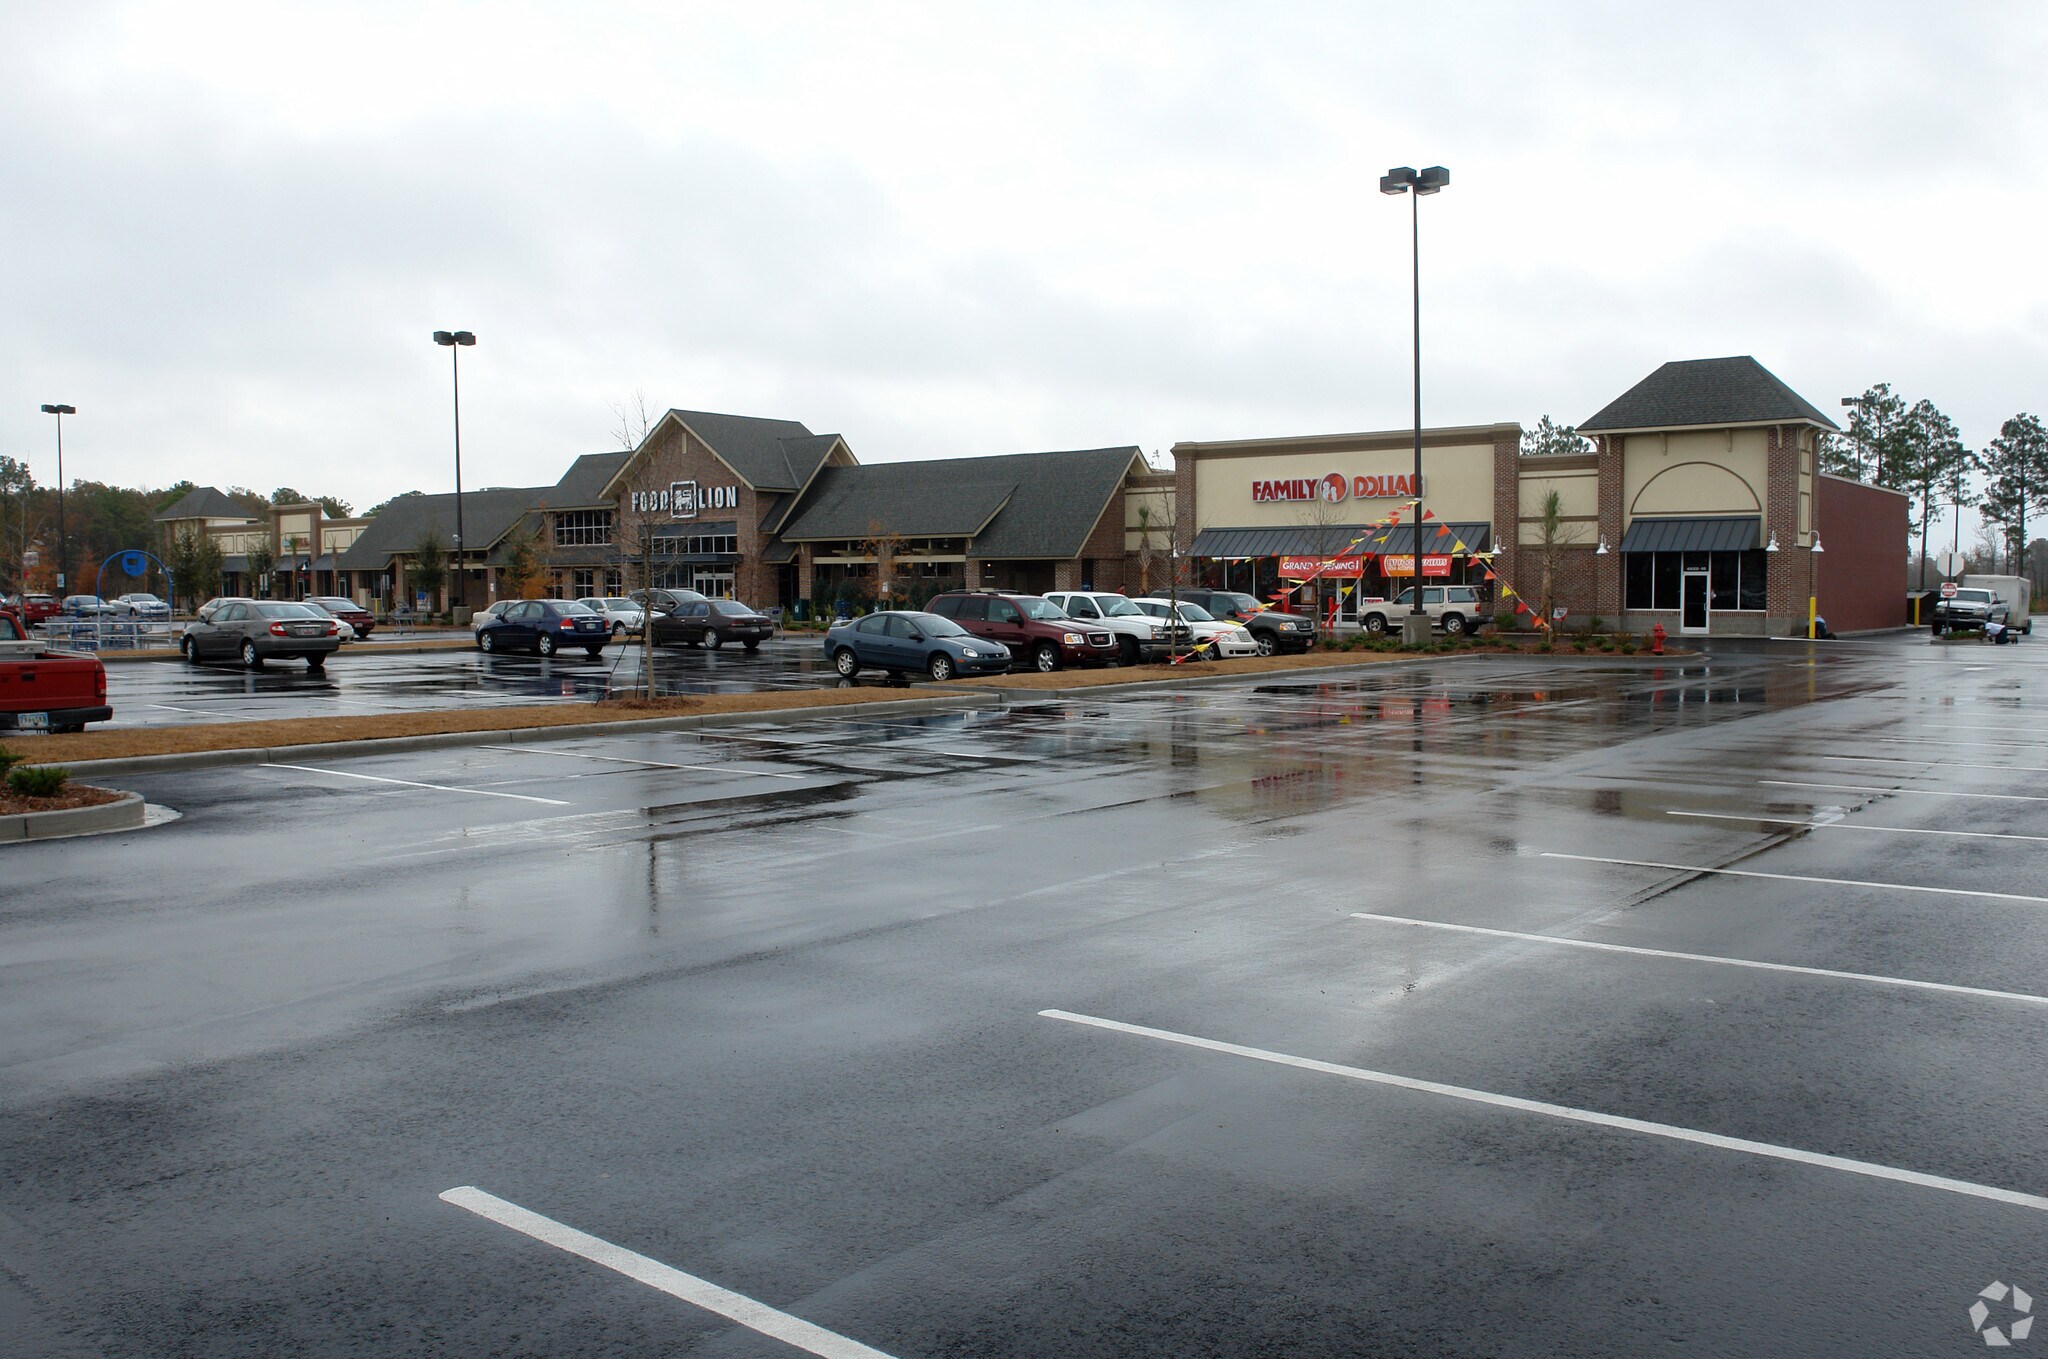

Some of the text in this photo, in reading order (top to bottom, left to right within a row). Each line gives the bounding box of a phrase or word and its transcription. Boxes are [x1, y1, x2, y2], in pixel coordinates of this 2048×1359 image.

[632, 486, 736, 512] FOOD LION
[1252, 478, 1318, 501] FAMILY
[1282, 562, 1313, 570] GRAND
